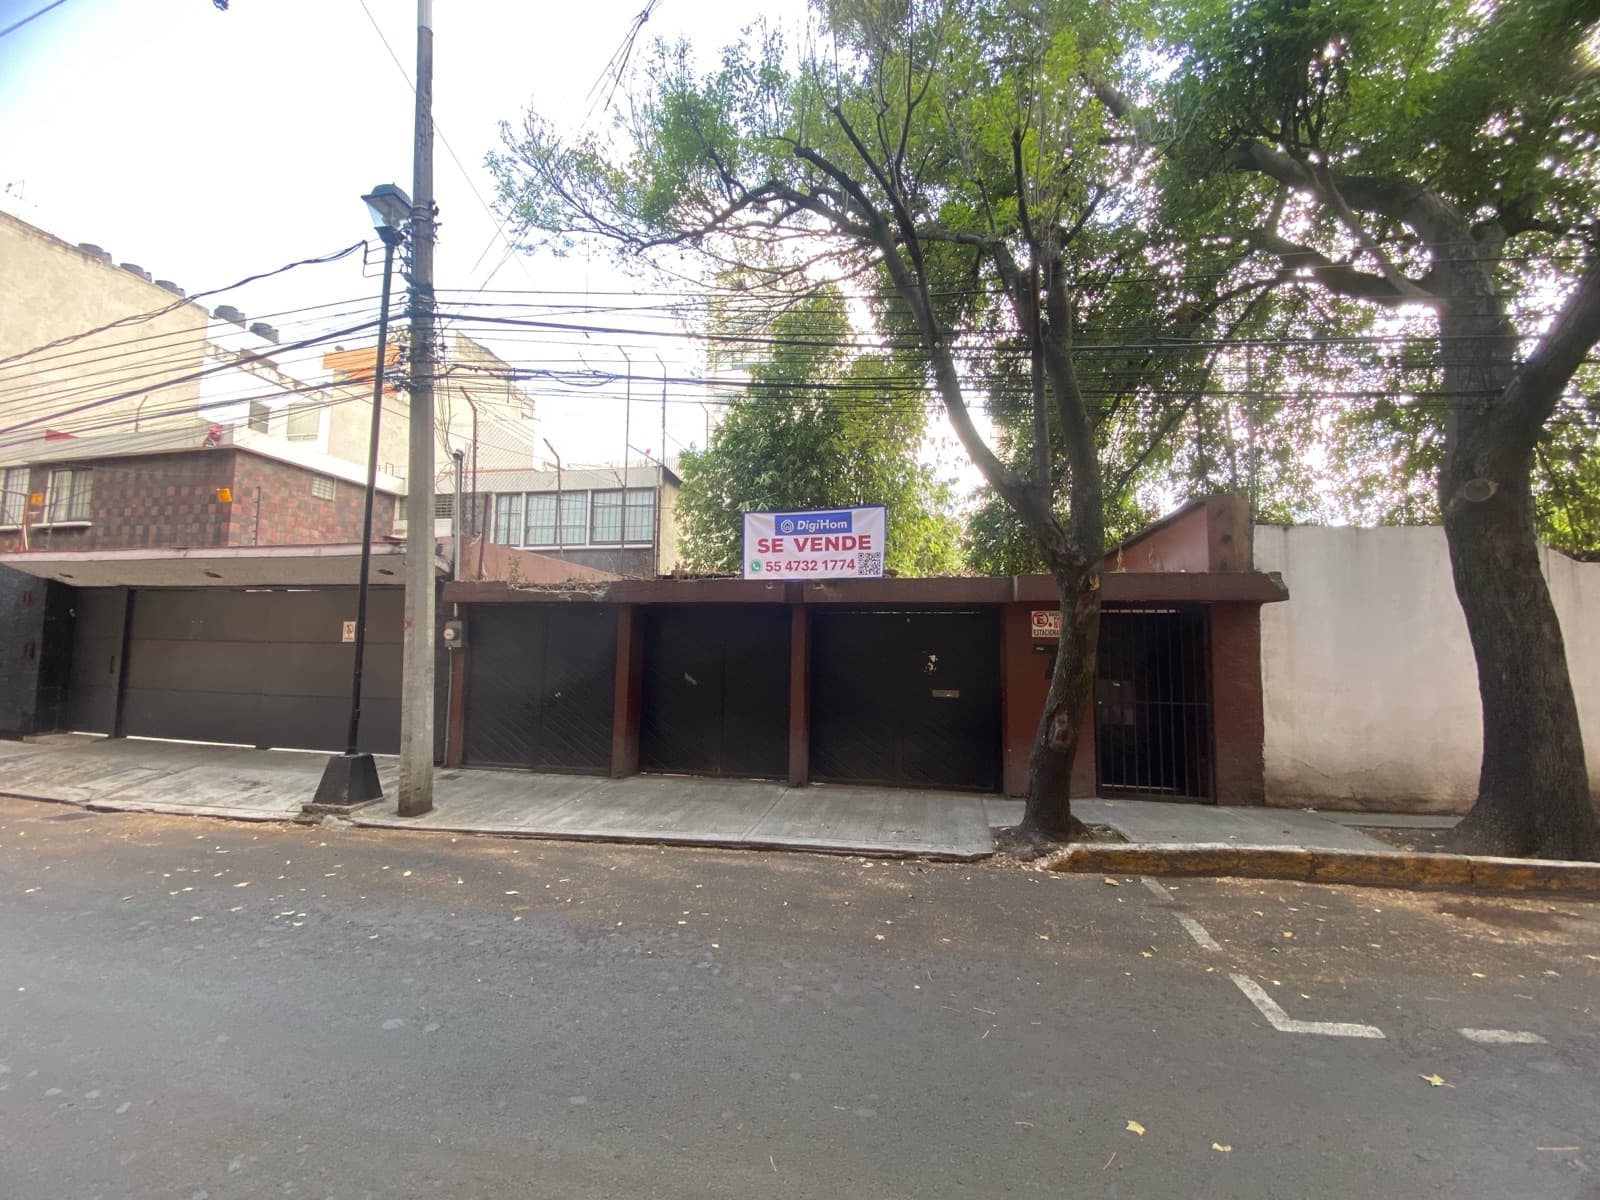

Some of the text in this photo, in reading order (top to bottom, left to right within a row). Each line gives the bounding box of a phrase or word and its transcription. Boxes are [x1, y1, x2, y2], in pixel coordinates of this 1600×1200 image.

[797, 519, 848, 533] DigiHom
[757, 535, 872, 554] SE VENDE
[765, 559, 856, 572] 55 4732 1774
